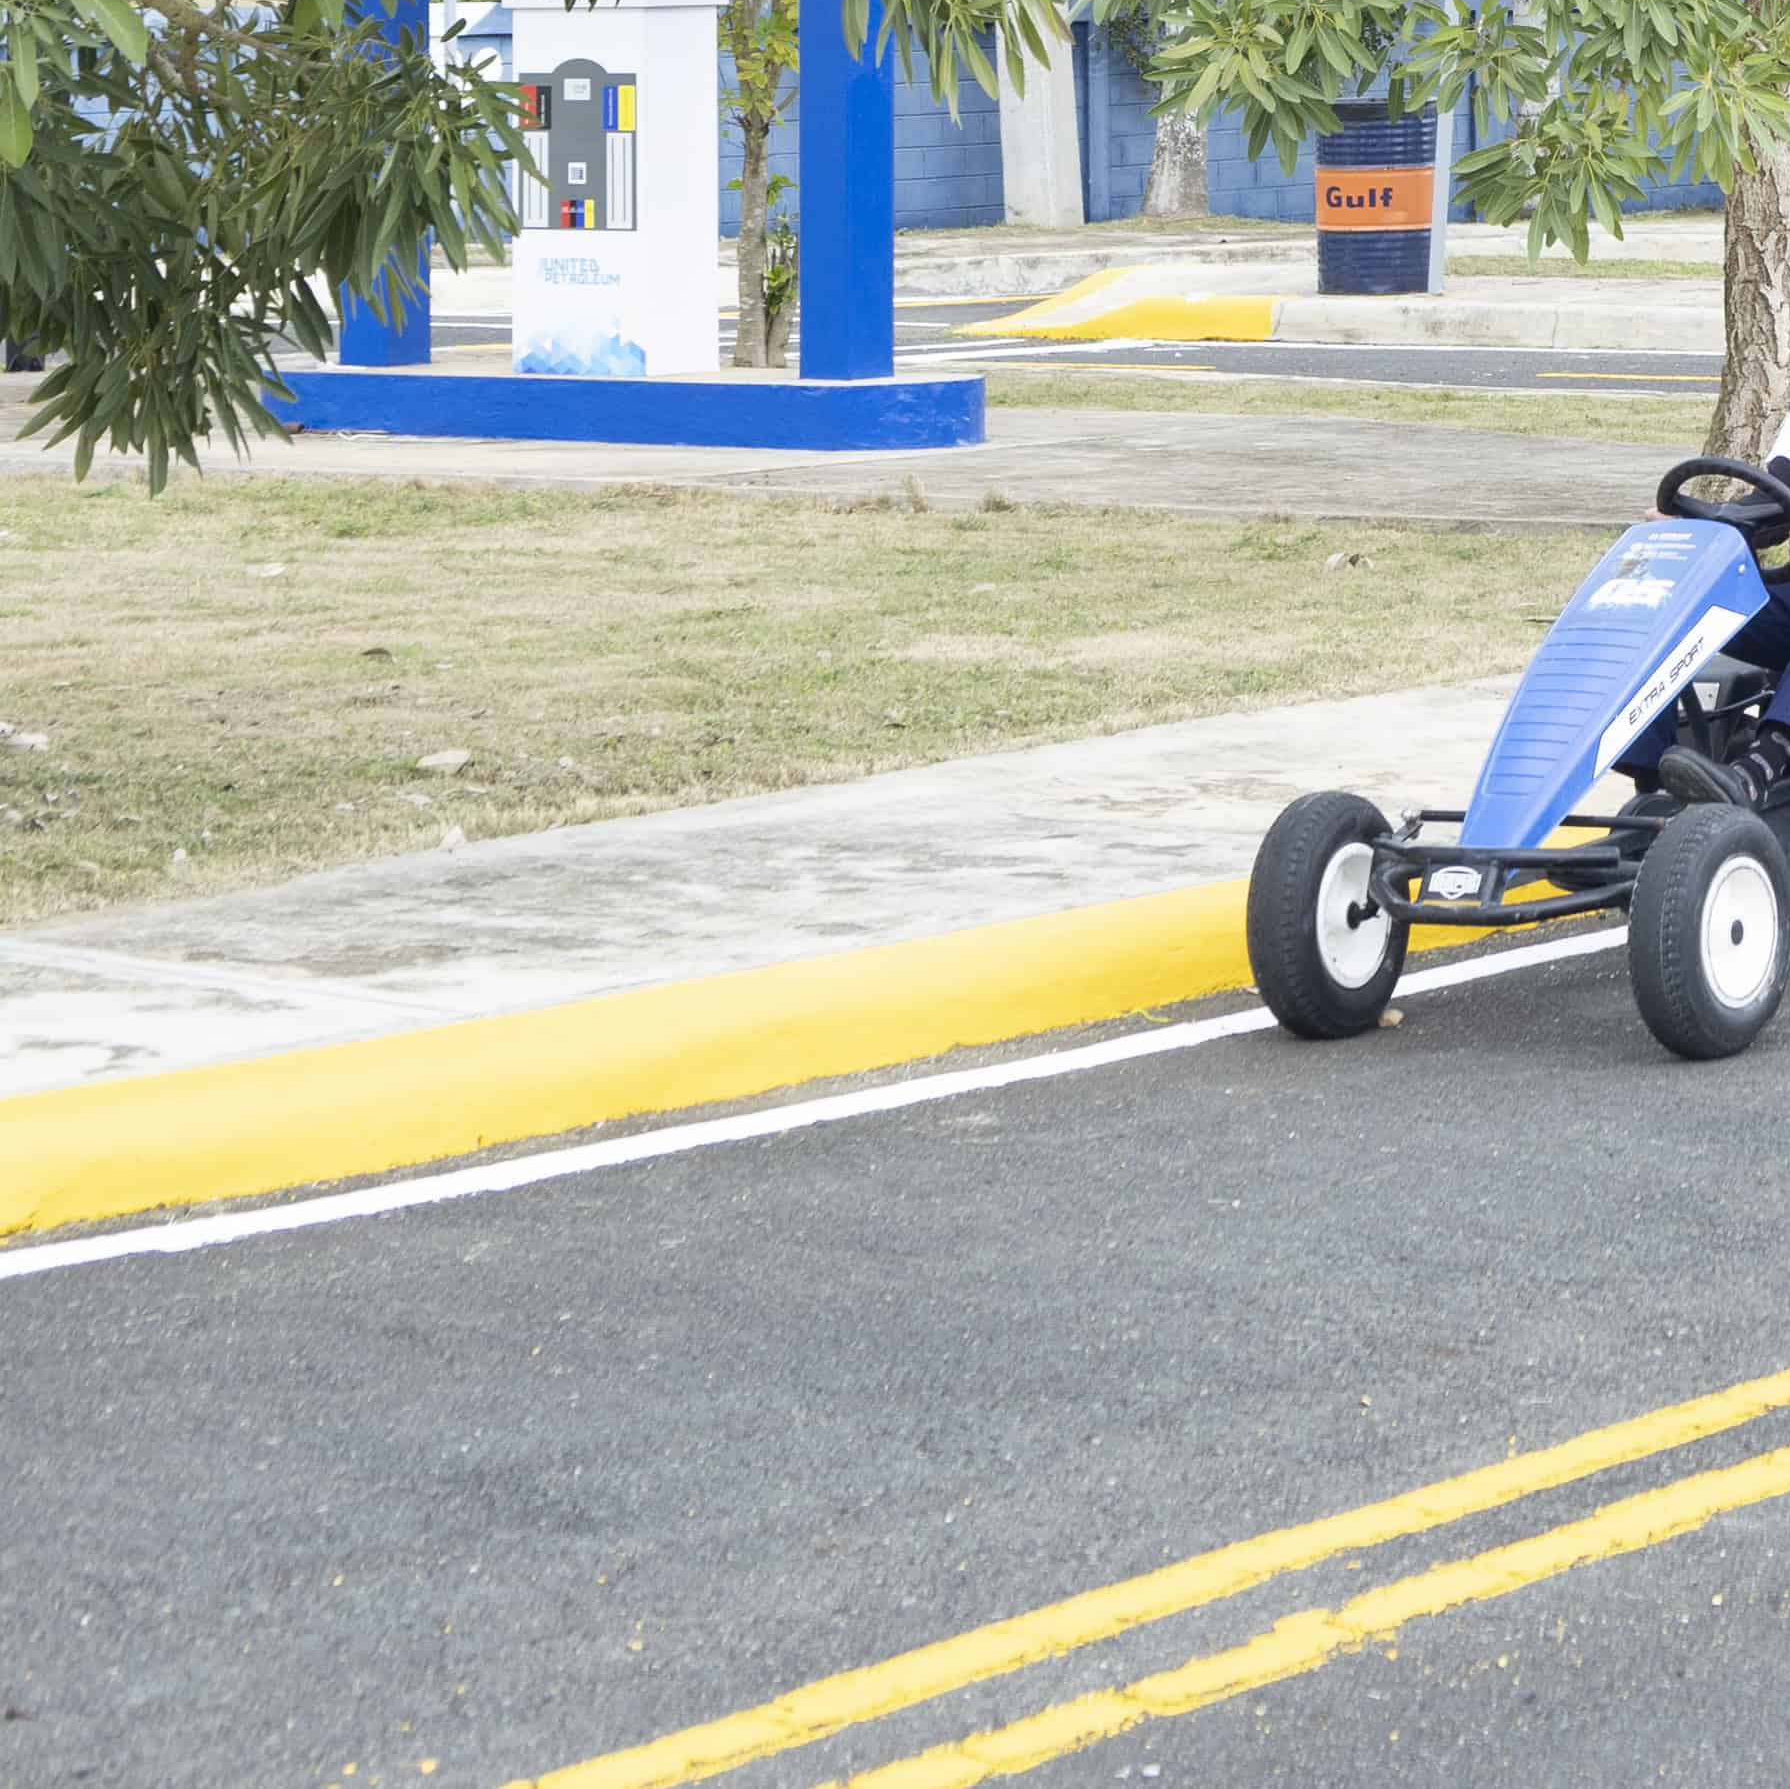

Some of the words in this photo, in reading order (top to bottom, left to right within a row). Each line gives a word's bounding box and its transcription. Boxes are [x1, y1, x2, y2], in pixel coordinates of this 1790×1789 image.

[1326, 186, 1392, 208] Gulf
[542, 257, 601, 272] UNITED
[1629, 681, 1665, 725] EXTRA
[1669, 636, 1704, 684] SPORT
